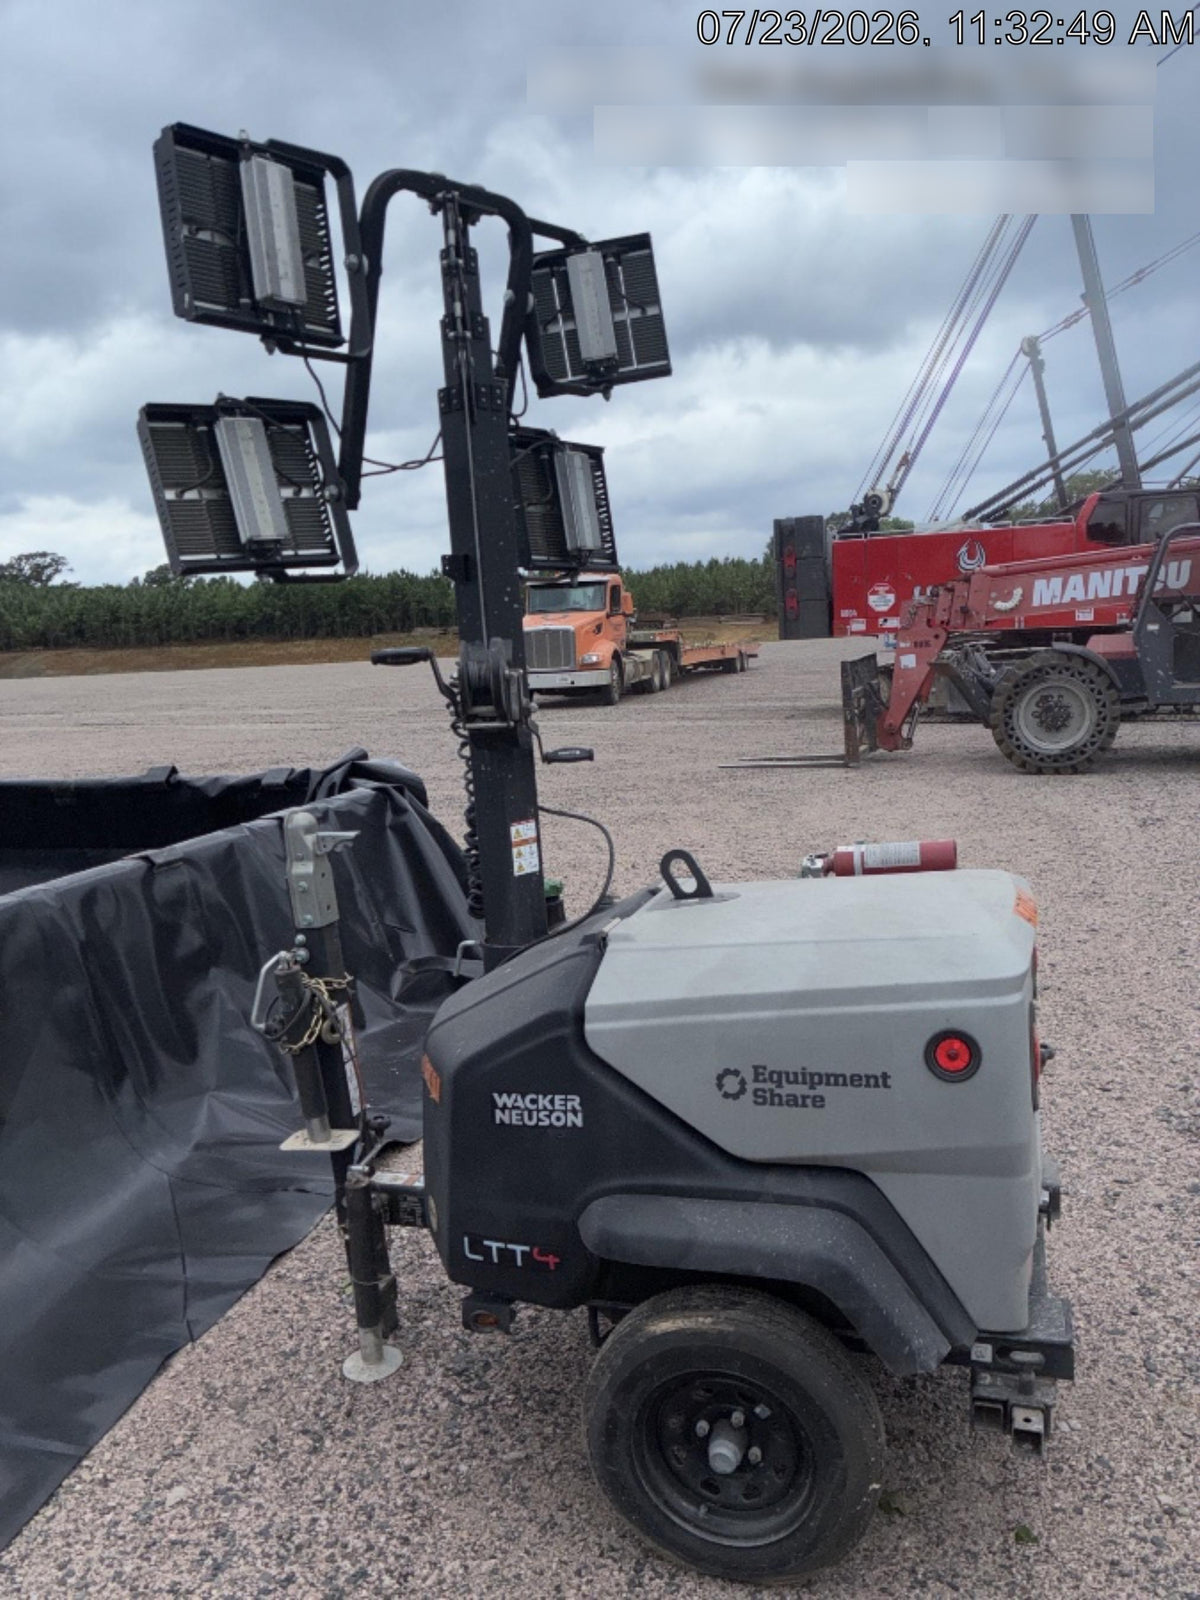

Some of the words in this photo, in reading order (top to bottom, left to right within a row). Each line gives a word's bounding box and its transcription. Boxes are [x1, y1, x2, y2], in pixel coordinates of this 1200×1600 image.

[752, 1065, 891, 1090] Equipment
[492, 1092, 582, 1111] WACKER
[752, 1088, 825, 1108] Share
[494, 1109, 583, 1127] NEUSON
[463, 1236, 560, 1270] LTT4
